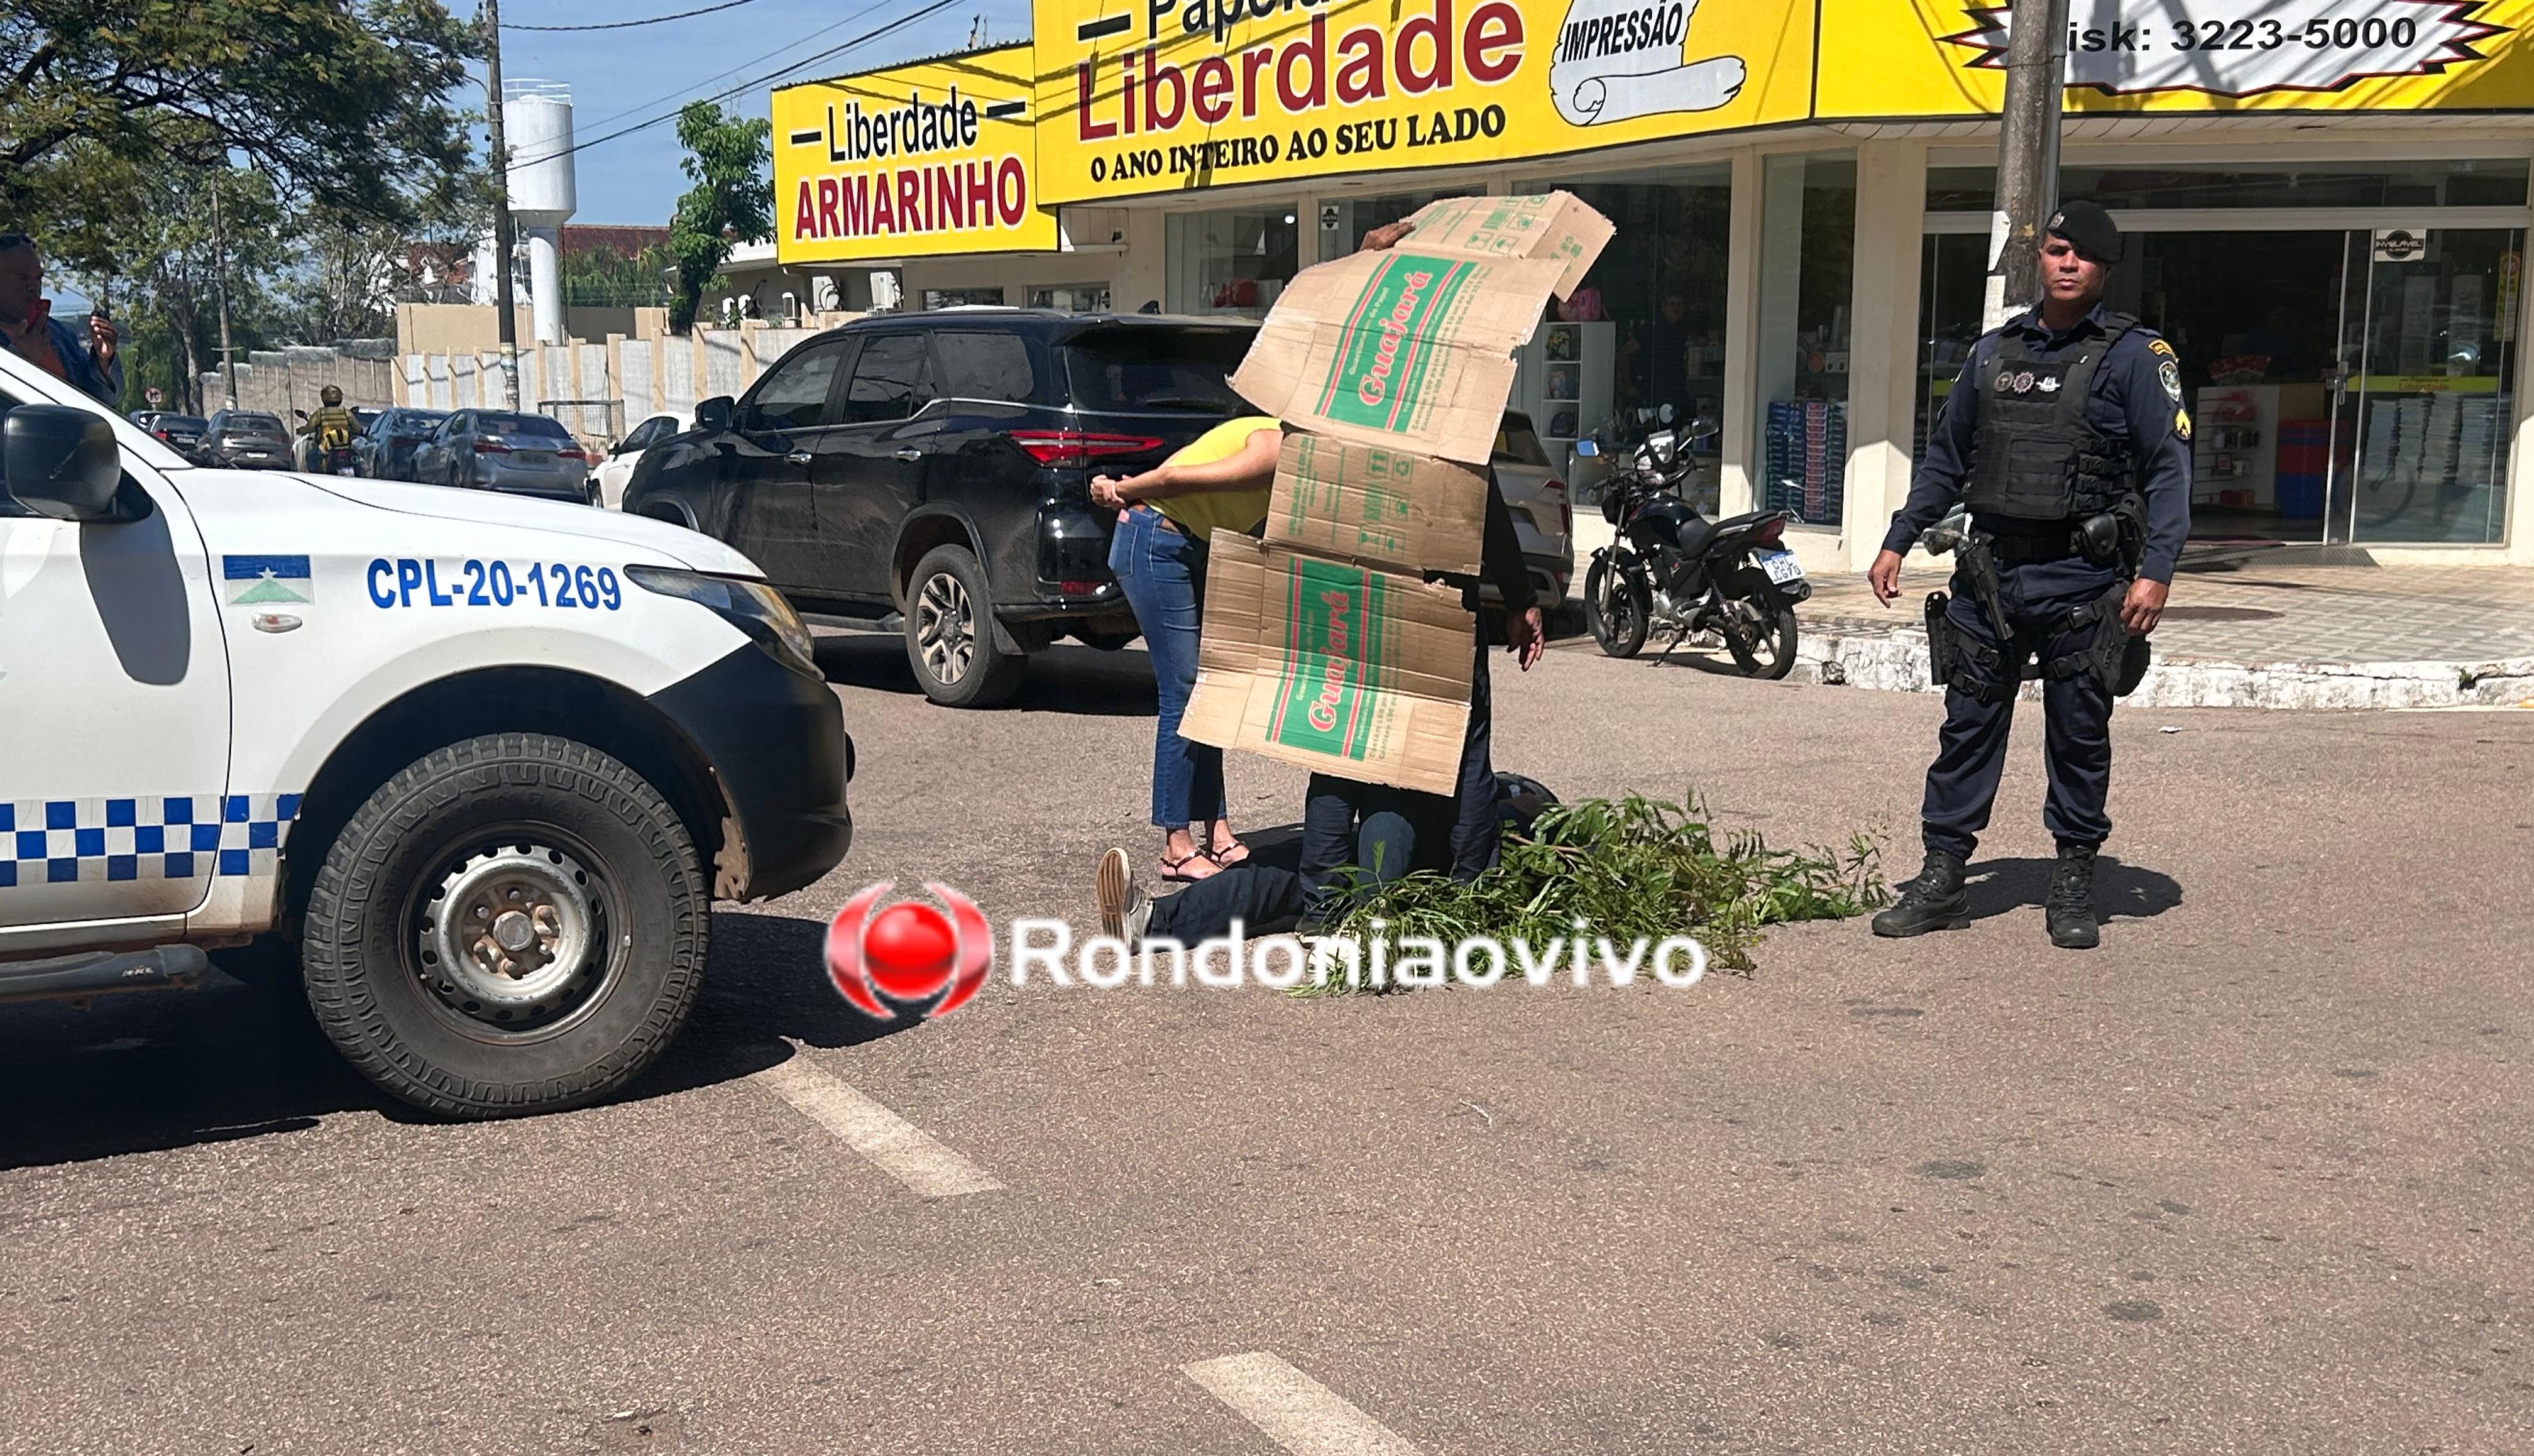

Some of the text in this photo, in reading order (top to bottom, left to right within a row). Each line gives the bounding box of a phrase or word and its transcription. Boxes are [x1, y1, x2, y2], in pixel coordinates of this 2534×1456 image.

[1078, 0, 1524, 141] Liberdade
[1562, 0, 1683, 62] IMPRESSÃO
[2068, 17, 2418, 52] isk: 3223-5000
[828, 85, 977, 162] Liberdade
[1090, 103, 1506, 182] O ANO INTEIRO AO SEU LADO
[795, 156, 1026, 240] ARMARINHO
[1359, 271, 1433, 407] Guajará
[367, 558, 622, 611] CPL-20-1269
[1308, 589, 1349, 731] Guajará
